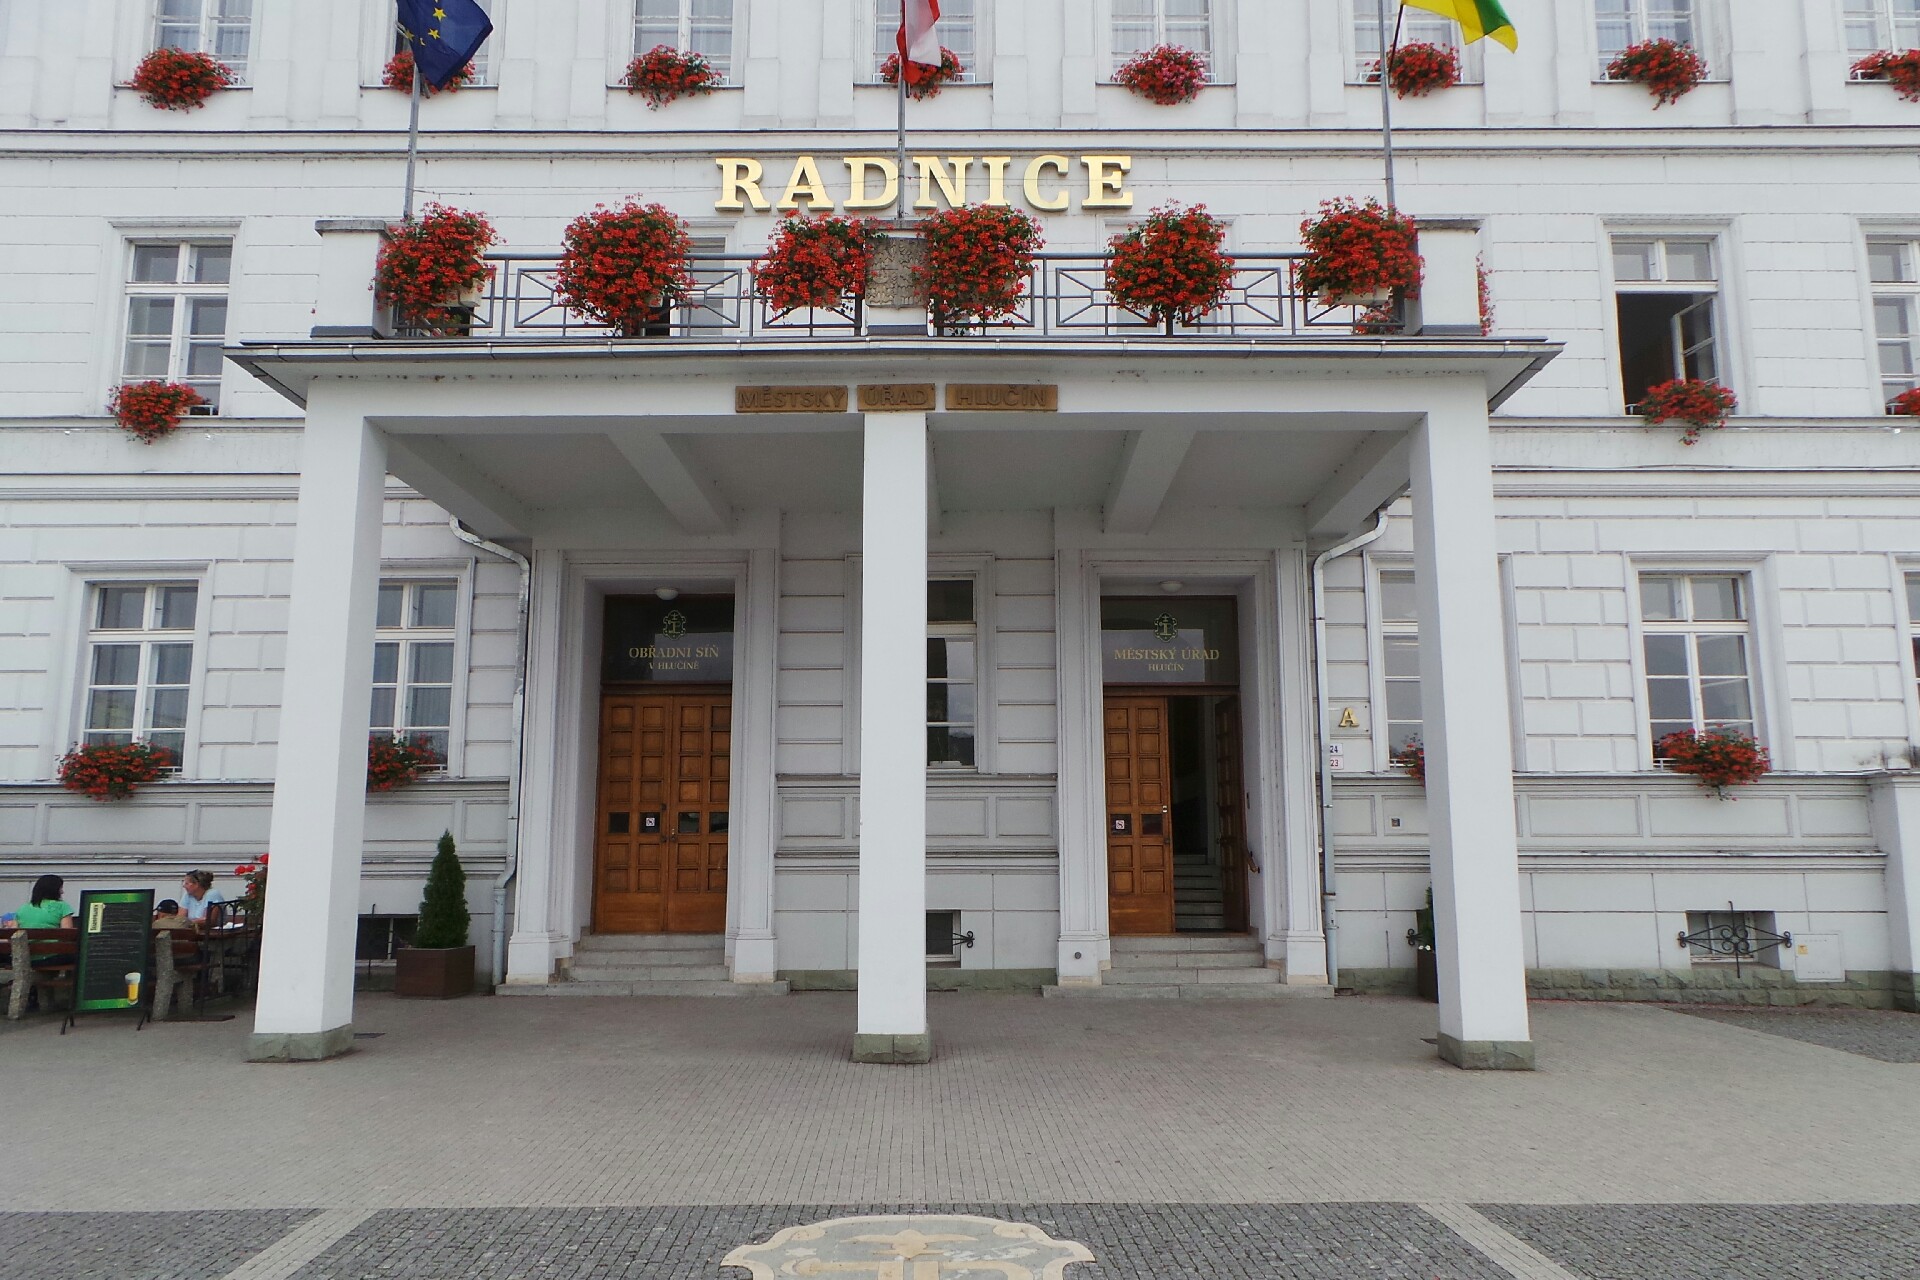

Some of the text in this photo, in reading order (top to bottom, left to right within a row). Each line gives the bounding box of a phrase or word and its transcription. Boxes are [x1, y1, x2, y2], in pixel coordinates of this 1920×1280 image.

[714, 155, 1134, 212] RADNICE
[737, 384, 1047, 409] MĚSTSKÝ ÚŘAD HLUČÍN
[1114, 647, 1219, 660] MĚSTSKÝ ÚŘAD
[1149, 662, 1184, 671] HLUČÍN
[1338, 707, 1360, 728] A
